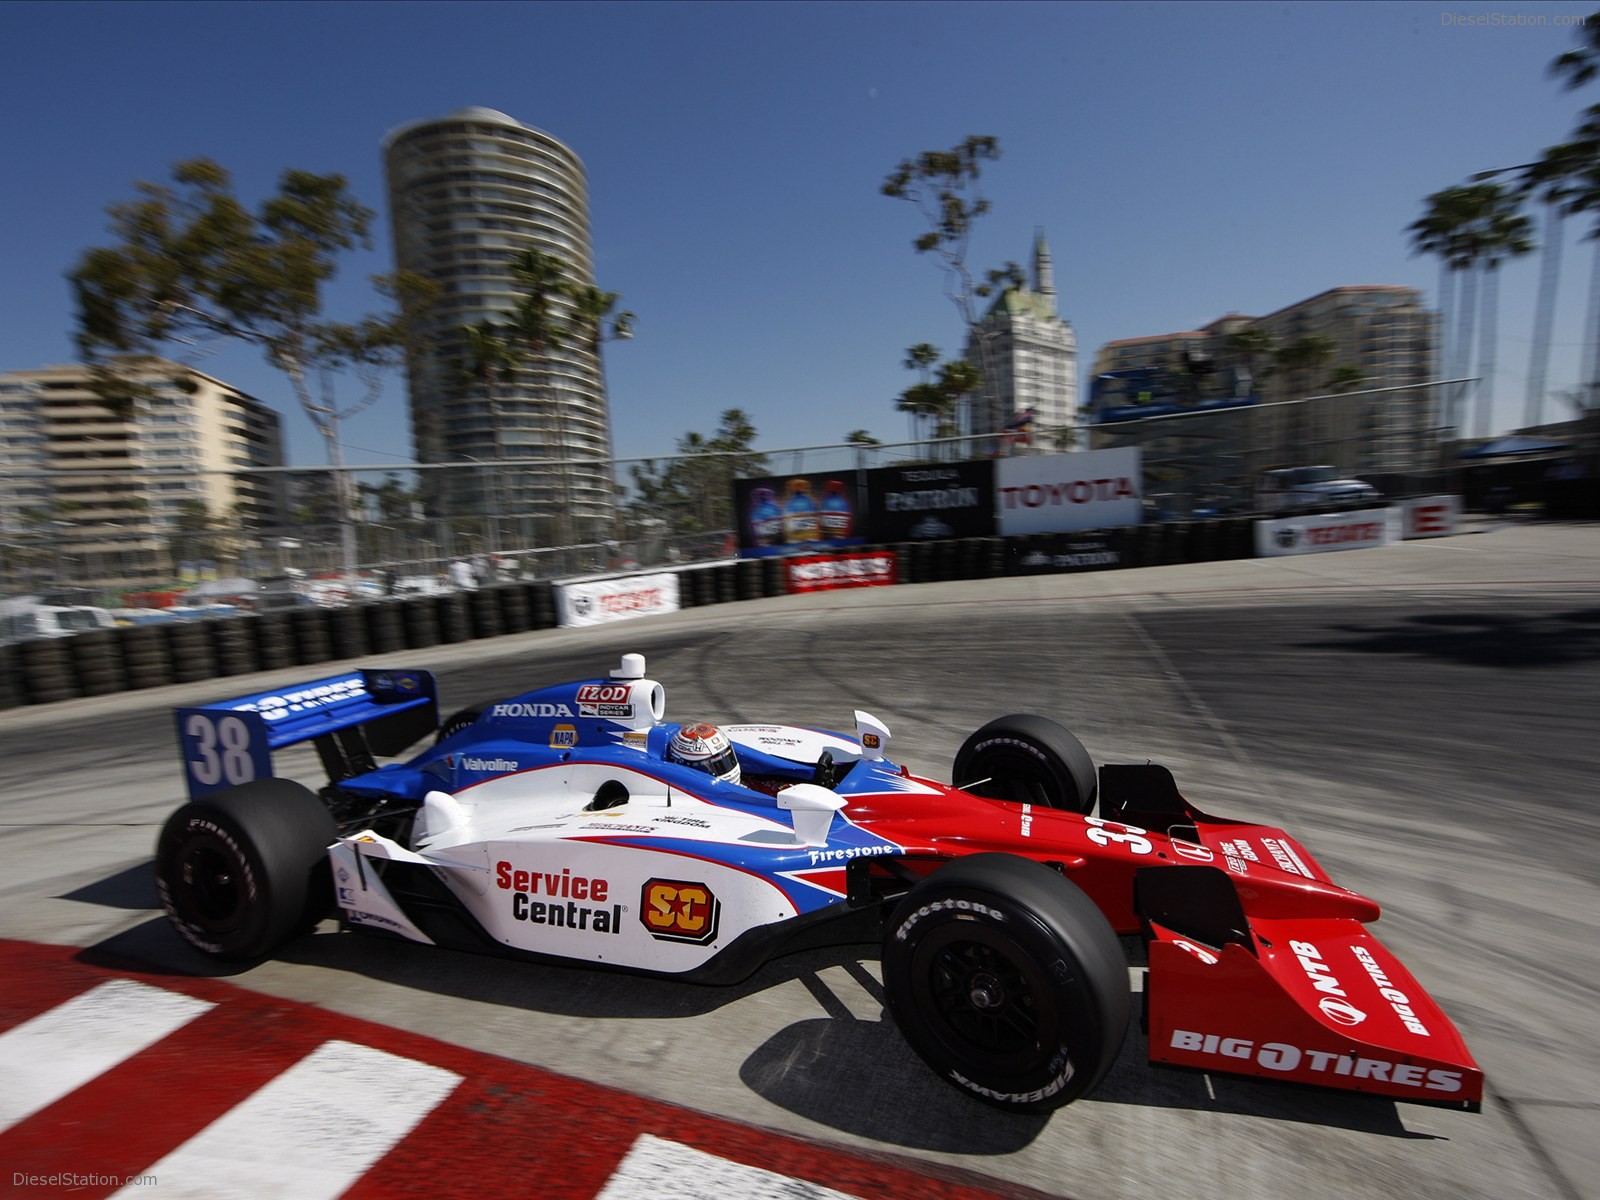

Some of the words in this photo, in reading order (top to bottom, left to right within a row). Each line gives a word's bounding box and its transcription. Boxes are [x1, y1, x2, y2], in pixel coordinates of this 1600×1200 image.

[997, 477, 1139, 509] TOYOTA
[491, 703, 575, 718] HONDA
[580, 686, 626, 701] IZOD
[186, 714, 255, 786] 38
[552, 731, 576, 746] NAPA
[462, 758, 518, 772] Valvoline
[808, 845, 893, 866] Firestone
[496, 860, 609, 903] Service
[648, 885, 707, 931] SC
[896, 898, 1005, 941] Firestone
[1288, 939, 1348, 997] NTB
[1350, 945, 1394, 988] TIRES
[1390, 1002, 1431, 1037] BIG
[949, 1056, 1076, 1104] FIREHAWK
[1170, 1029, 1254, 1060] BIG
[1256, 1042, 1302, 1072] O
[1305, 1049, 1463, 1093] TIRES
